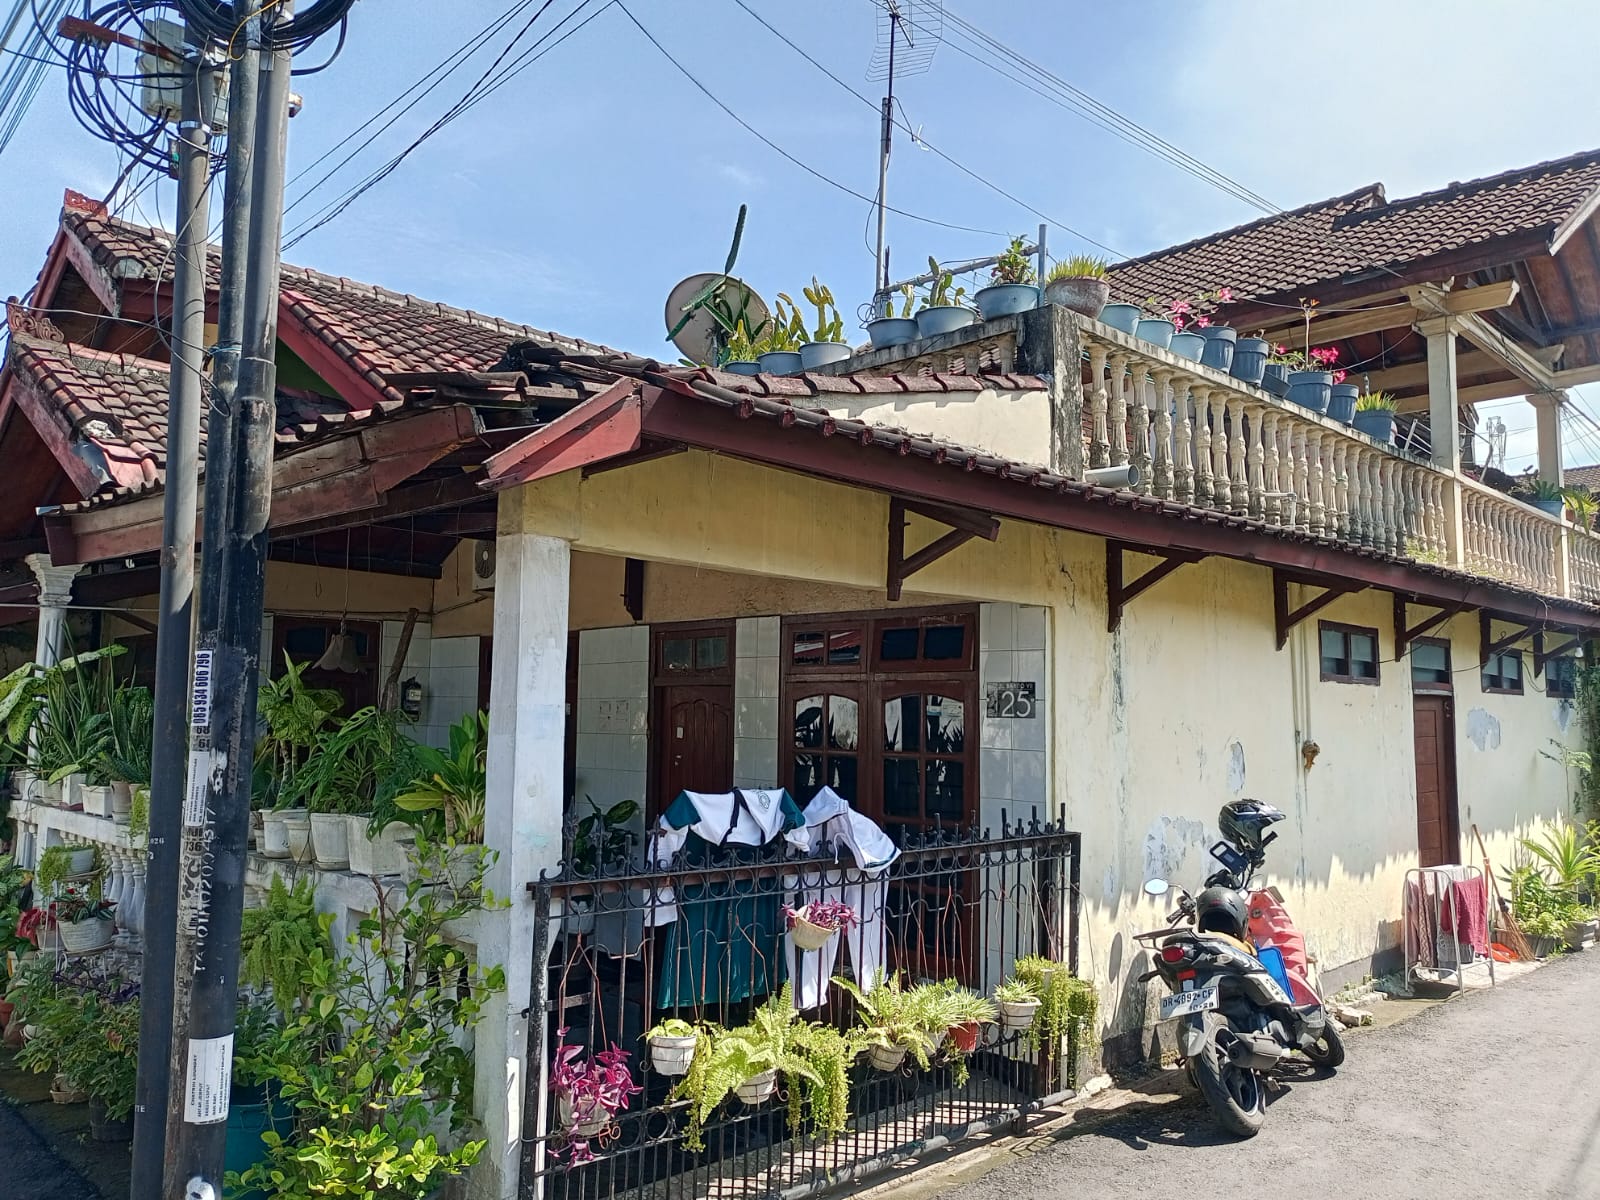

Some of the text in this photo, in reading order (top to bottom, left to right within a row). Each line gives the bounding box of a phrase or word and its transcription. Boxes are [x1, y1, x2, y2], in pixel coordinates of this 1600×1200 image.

[193, 653, 210, 724] 085 934 606 796
[1002, 691, 1031, 717] 25
